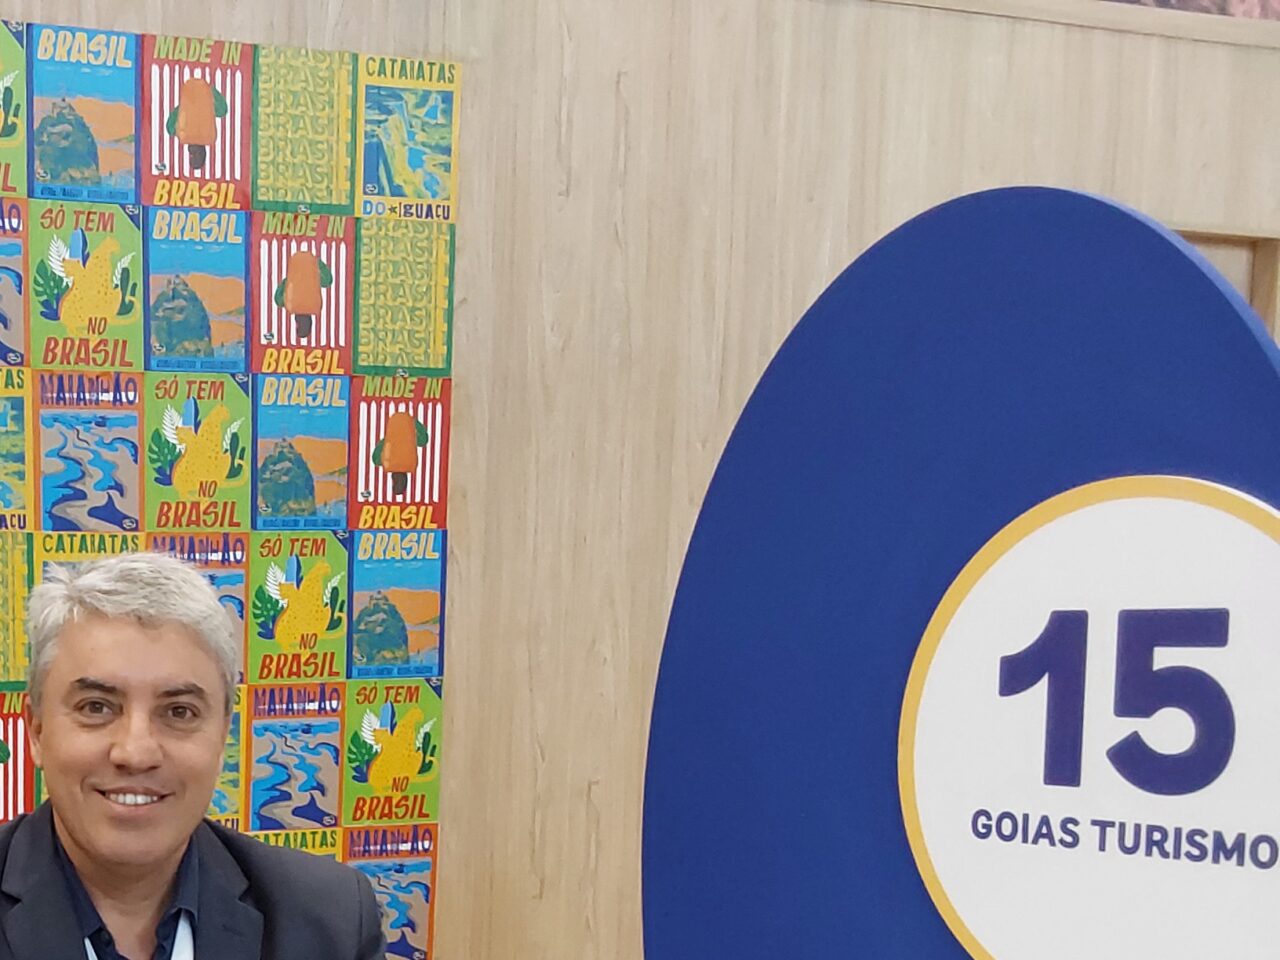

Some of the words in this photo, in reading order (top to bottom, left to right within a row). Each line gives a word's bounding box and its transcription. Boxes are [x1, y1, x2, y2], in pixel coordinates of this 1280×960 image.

[37, 29, 132, 69] BRASIL
[153, 36, 213, 63] MADE
[222, 43, 241, 66] IN
[153, 181, 241, 210] BRASIL
[362, 199, 386, 216] DO
[40, 204, 65, 230] SÓ
[73, 209, 115, 233] TEM
[152, 210, 242, 244] BRASIL
[262, 211, 320, 237] MADE
[327, 216, 346, 238] IN
[87, 316, 107, 334] NO
[43, 337, 133, 368] BRASIL
[262, 349, 344, 374] BRASIL
[154, 375, 179, 400] SÓ
[185, 379, 224, 401] TEM
[261, 377, 346, 408] BRASIL
[362, 376, 417, 398] MADE
[425, 379, 441, 400] IN
[198, 480, 217, 498] NO
[156, 500, 241, 528] BRASIL
[359, 505, 437, 529] BRASIL
[259, 533, 282, 557] SÓ
[289, 537, 326, 557] TEM
[357, 533, 439, 561] BRASIL
[299, 633, 317, 650] NO
[258, 653, 340, 680] BRASIL
[2, 692, 26, 714] IN
[356, 682, 377, 705] SÓ
[384, 686, 419, 704] TEM
[998, 608, 1236, 797] 15
[391, 776, 409, 793] NO
[352, 794, 429, 821] BRASIL
[971, 808, 1080, 850] GOIAS
[1091, 818, 1280, 870] TURISMO
